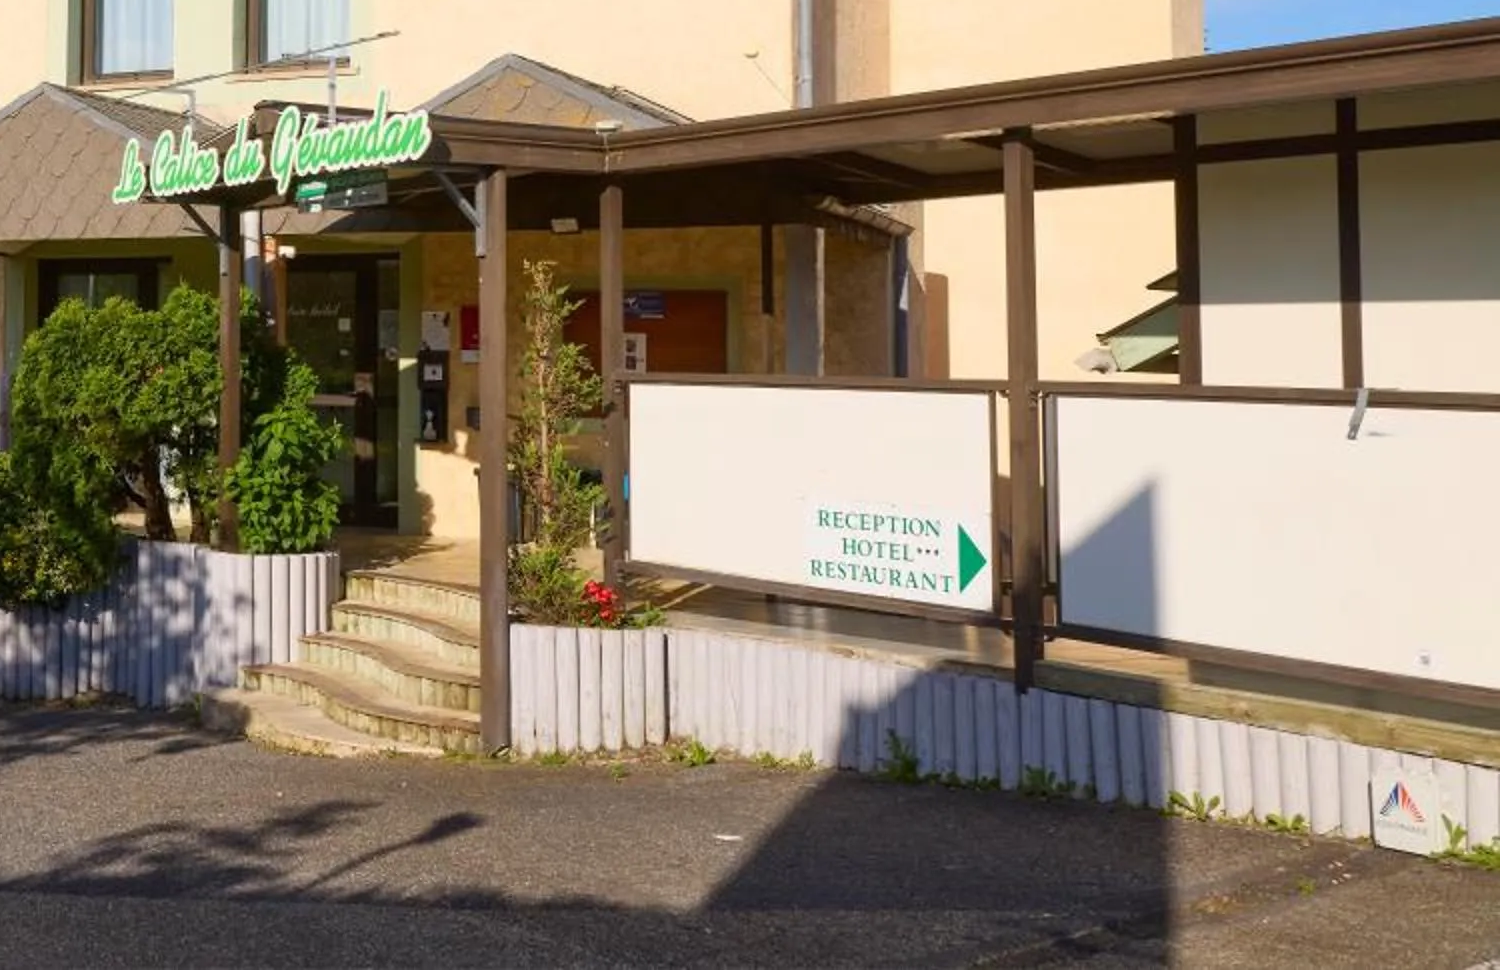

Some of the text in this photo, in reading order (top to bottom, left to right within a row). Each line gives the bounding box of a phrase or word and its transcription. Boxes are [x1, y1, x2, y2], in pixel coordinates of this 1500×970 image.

[112, 138, 146, 203] Le
[224, 117, 264, 184] du
[271, 87, 432, 194] Gévaudan
[818, 509, 941, 537] RECEPTION
[810, 559, 953, 593] RESTAURANT
